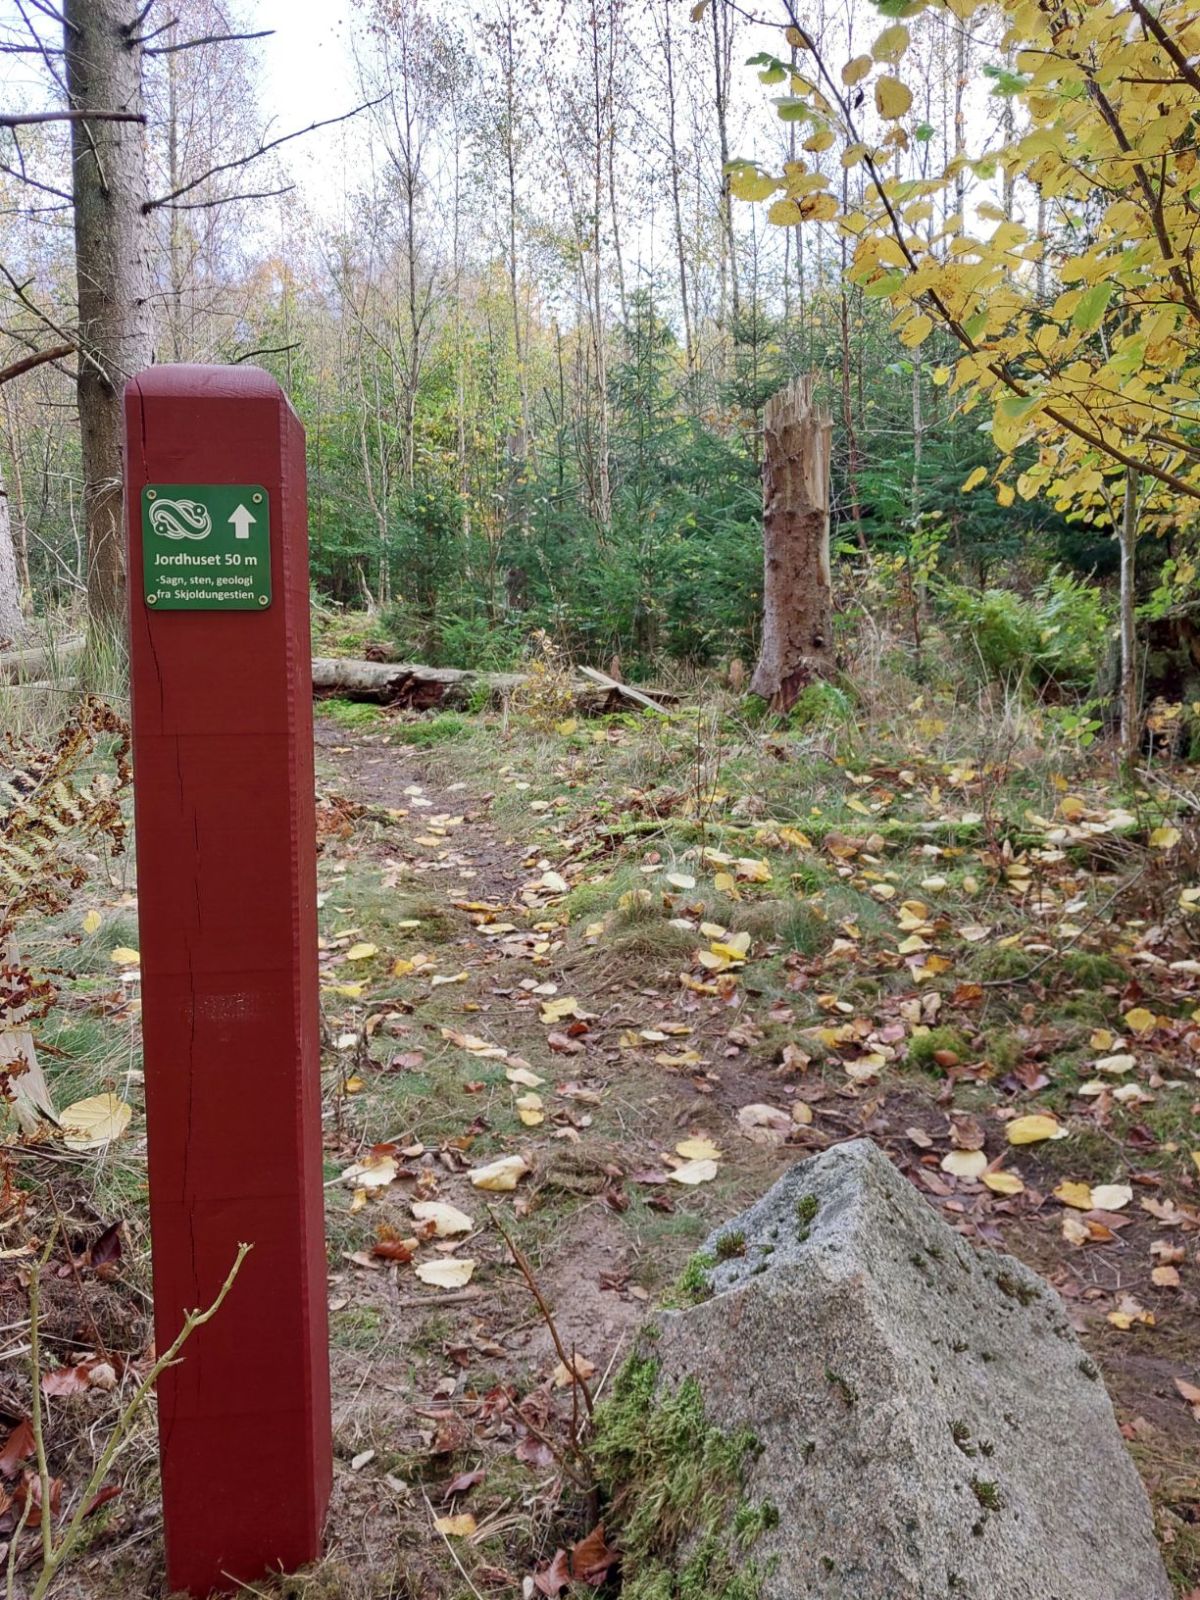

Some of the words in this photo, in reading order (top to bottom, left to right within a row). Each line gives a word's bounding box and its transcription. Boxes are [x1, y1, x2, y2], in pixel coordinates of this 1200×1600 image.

[154, 553, 221, 566] Jordhuset
[225, 553, 241, 566] 50
[244, 556, 258, 566] m
[155, 575, 187, 586] -Sagn,
[189, 576, 214, 586] sten,
[216, 575, 253, 587] geologi
[156, 589, 171, 599] fra
[174, 589, 255, 601] Skjoldungestien
